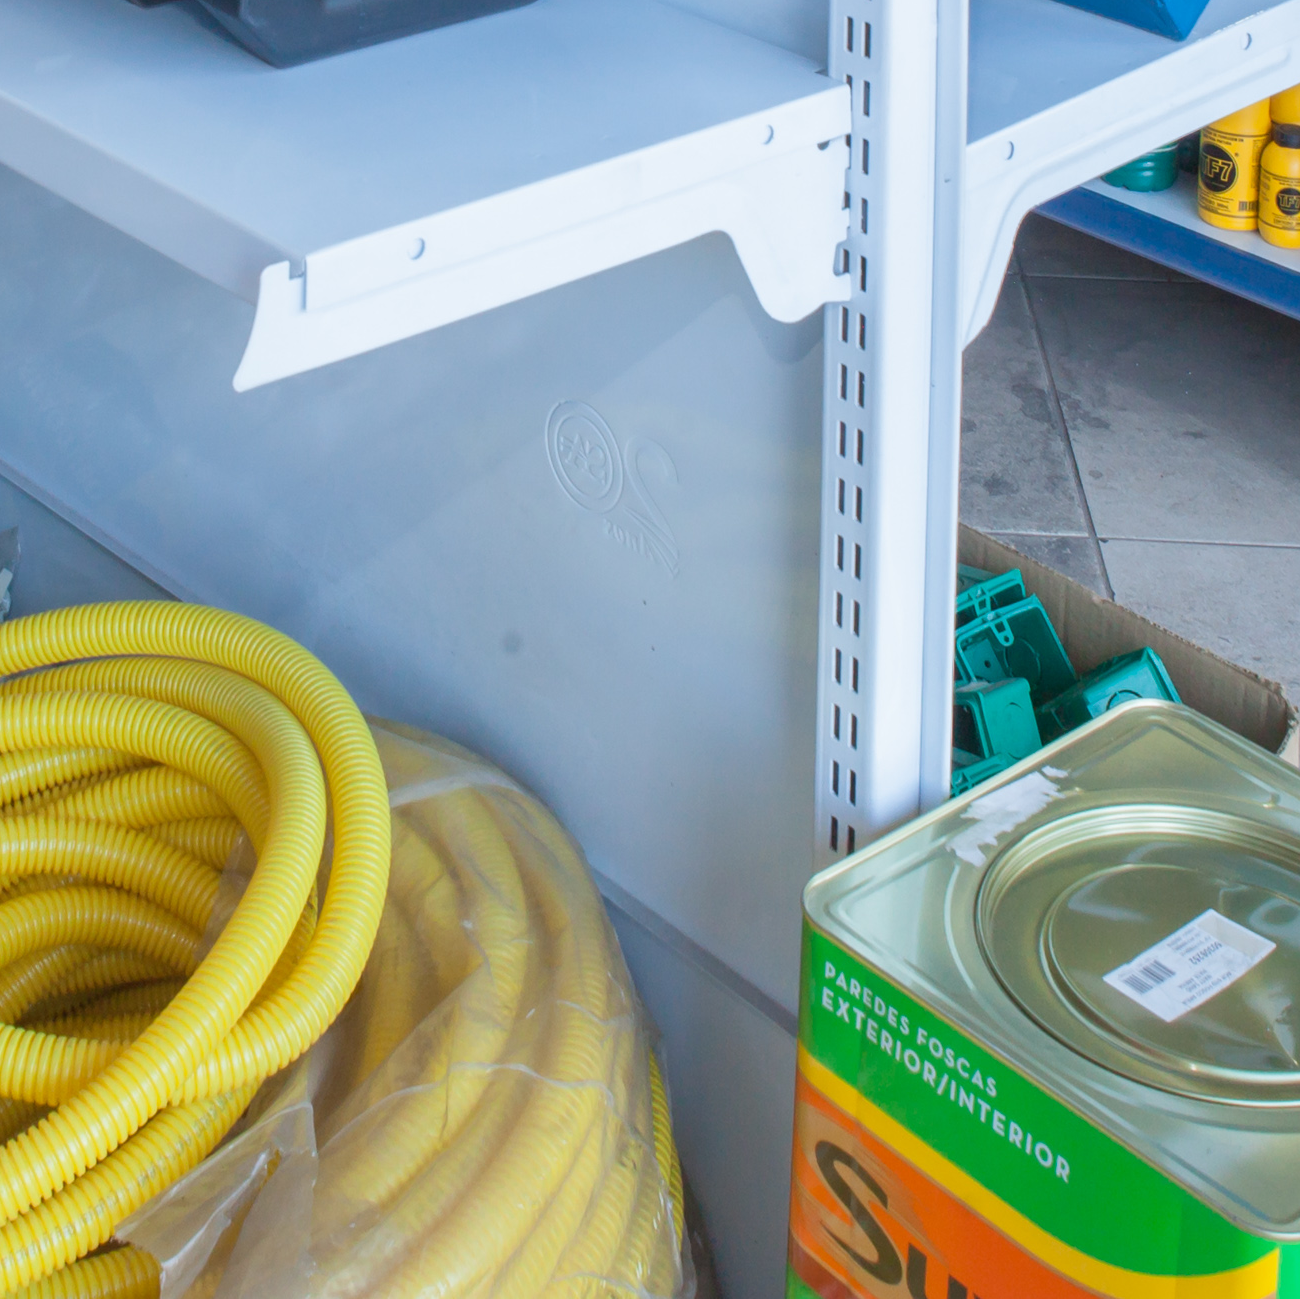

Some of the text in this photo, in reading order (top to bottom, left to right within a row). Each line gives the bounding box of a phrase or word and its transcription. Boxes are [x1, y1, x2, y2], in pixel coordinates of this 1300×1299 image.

[821, 987, 1071, 1184] EXTERIOR/INTERIOR
[823, 960, 998, 1098] PAREDES FOSCAS
